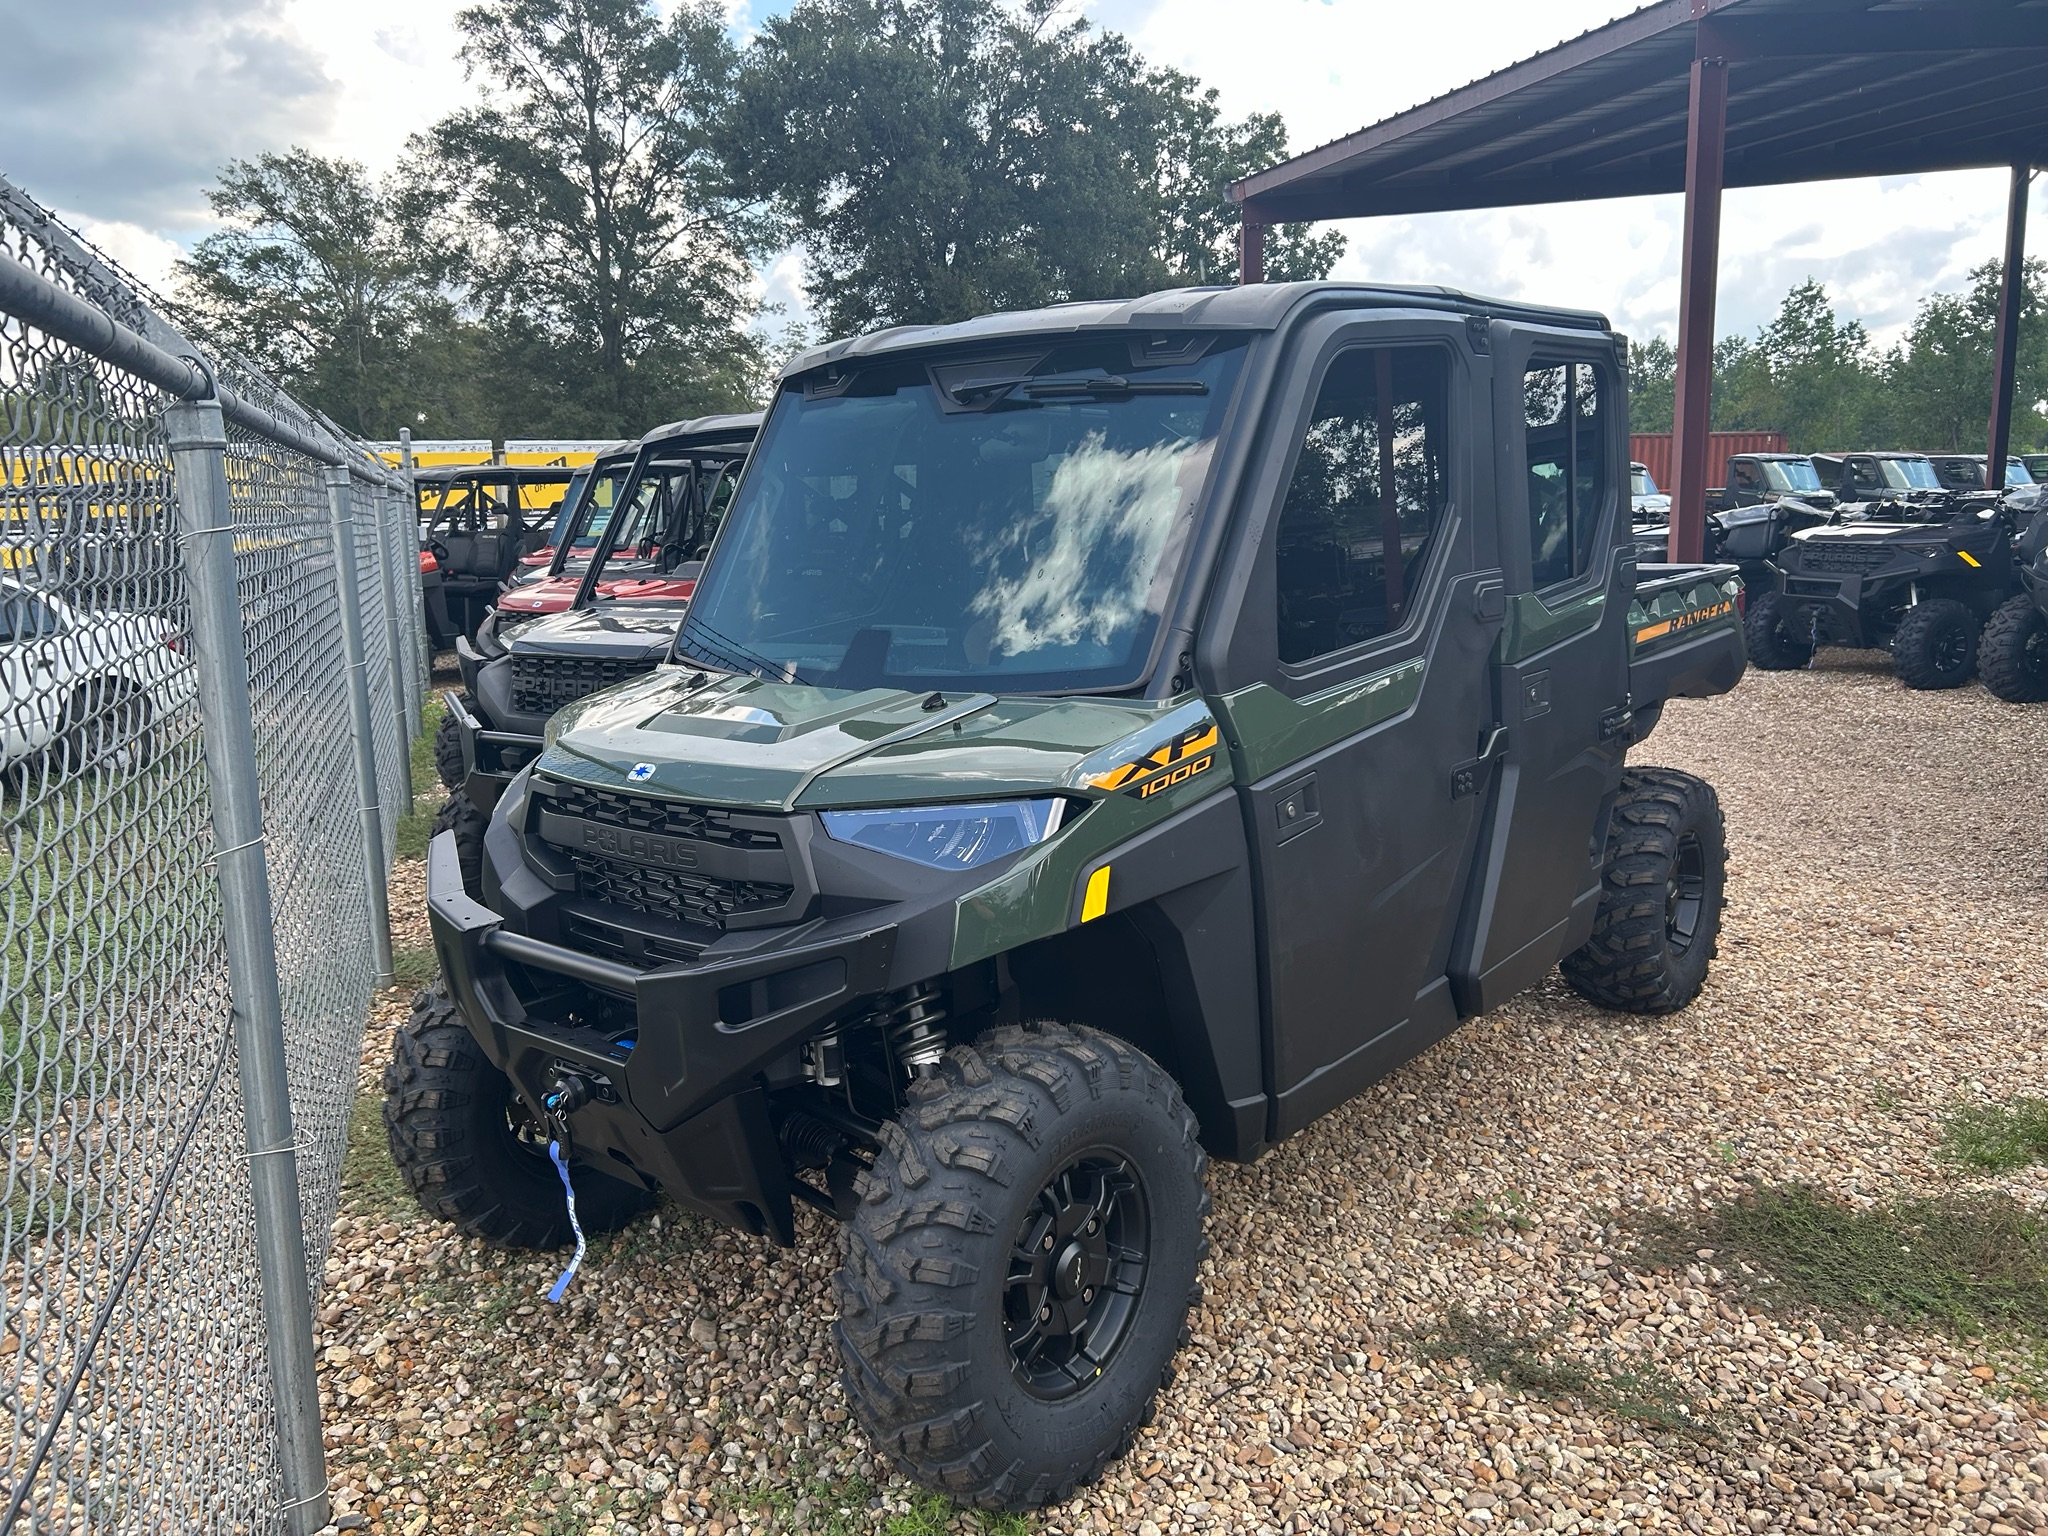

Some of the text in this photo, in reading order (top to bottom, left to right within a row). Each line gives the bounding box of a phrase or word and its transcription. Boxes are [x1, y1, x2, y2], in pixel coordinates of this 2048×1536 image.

[1812, 552, 1867, 563] POLARIS
[1670, 602, 1727, 632] RANGER
[1114, 722, 1213, 787] XP
[1141, 755, 1211, 799] 1000
[583, 824, 699, 869] POLARIS
[567, 1195, 586, 1274] POLARIS
